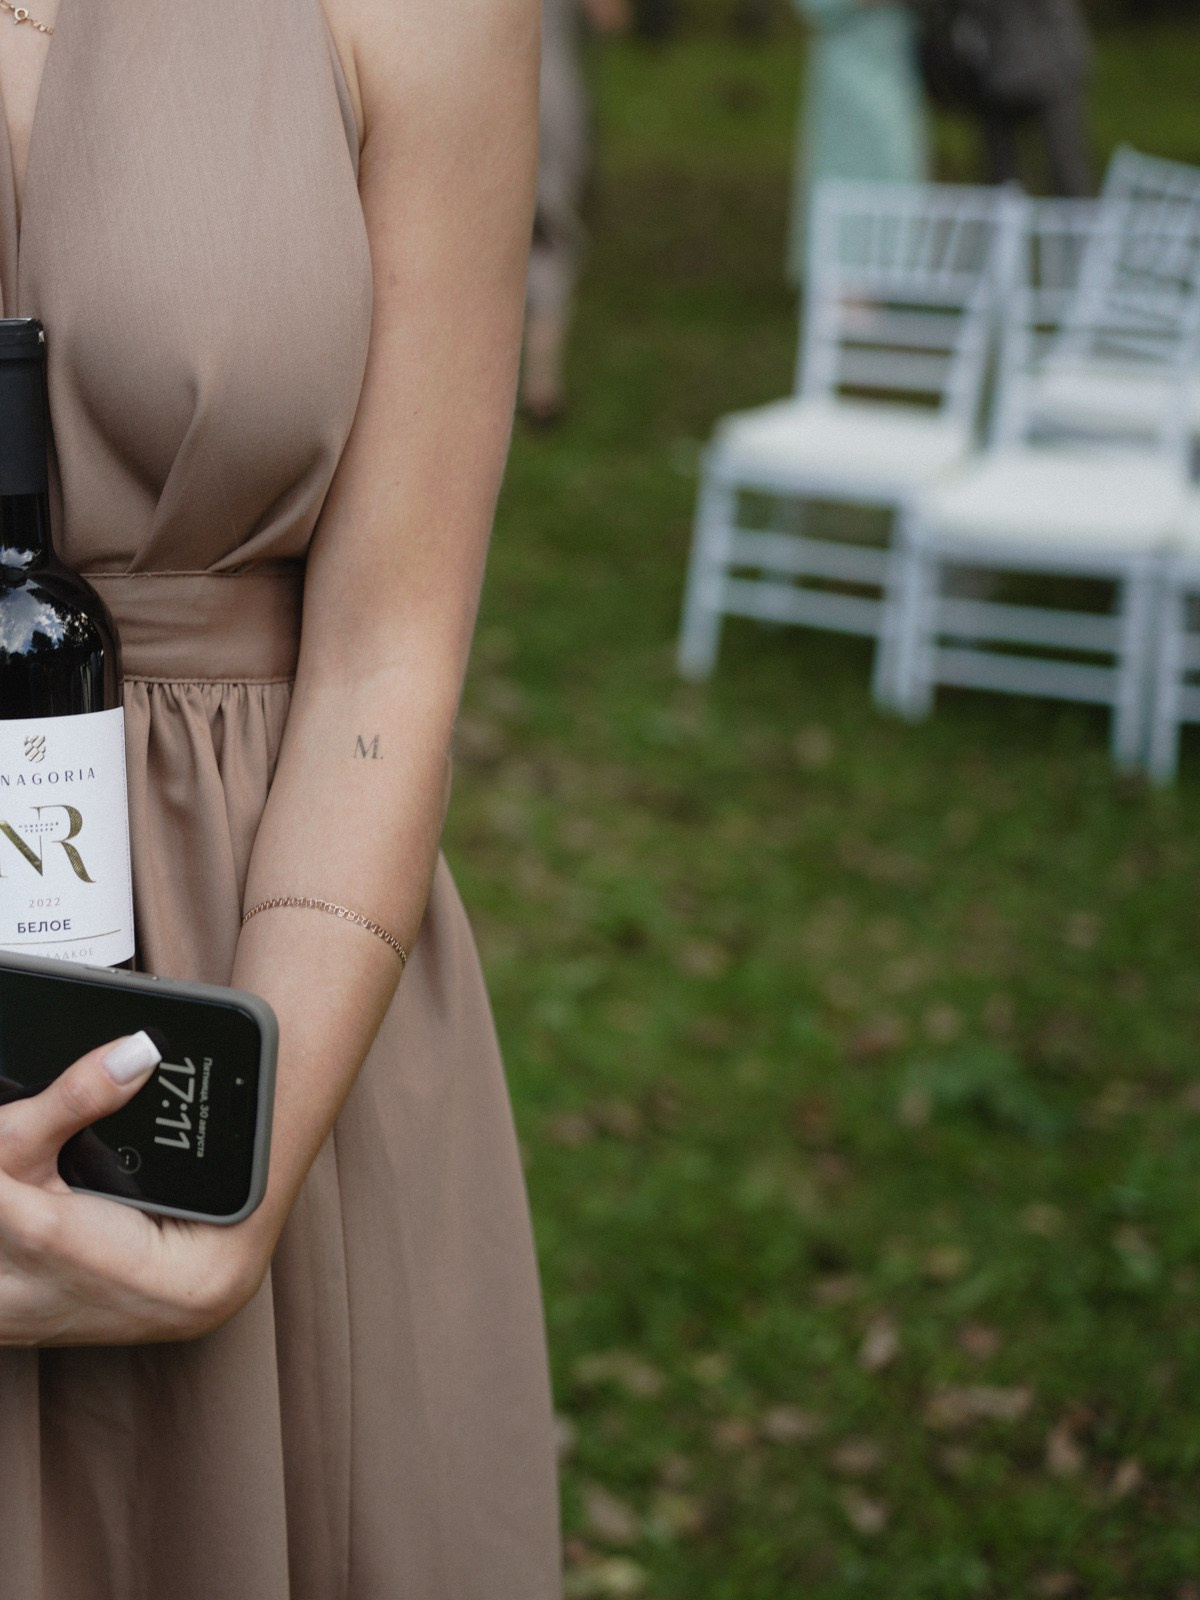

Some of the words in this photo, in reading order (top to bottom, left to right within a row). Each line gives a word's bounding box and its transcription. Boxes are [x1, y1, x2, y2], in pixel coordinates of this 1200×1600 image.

[28, 897, 61, 909] 2022
[17, 919, 72, 933] БЕЛОЕ
[200, 1057, 213, 1103] Пятница,
[153, 1056, 196, 1150] 17:11
[199, 1104, 210, 1119] 30
[196, 1119, 207, 1158] августа
